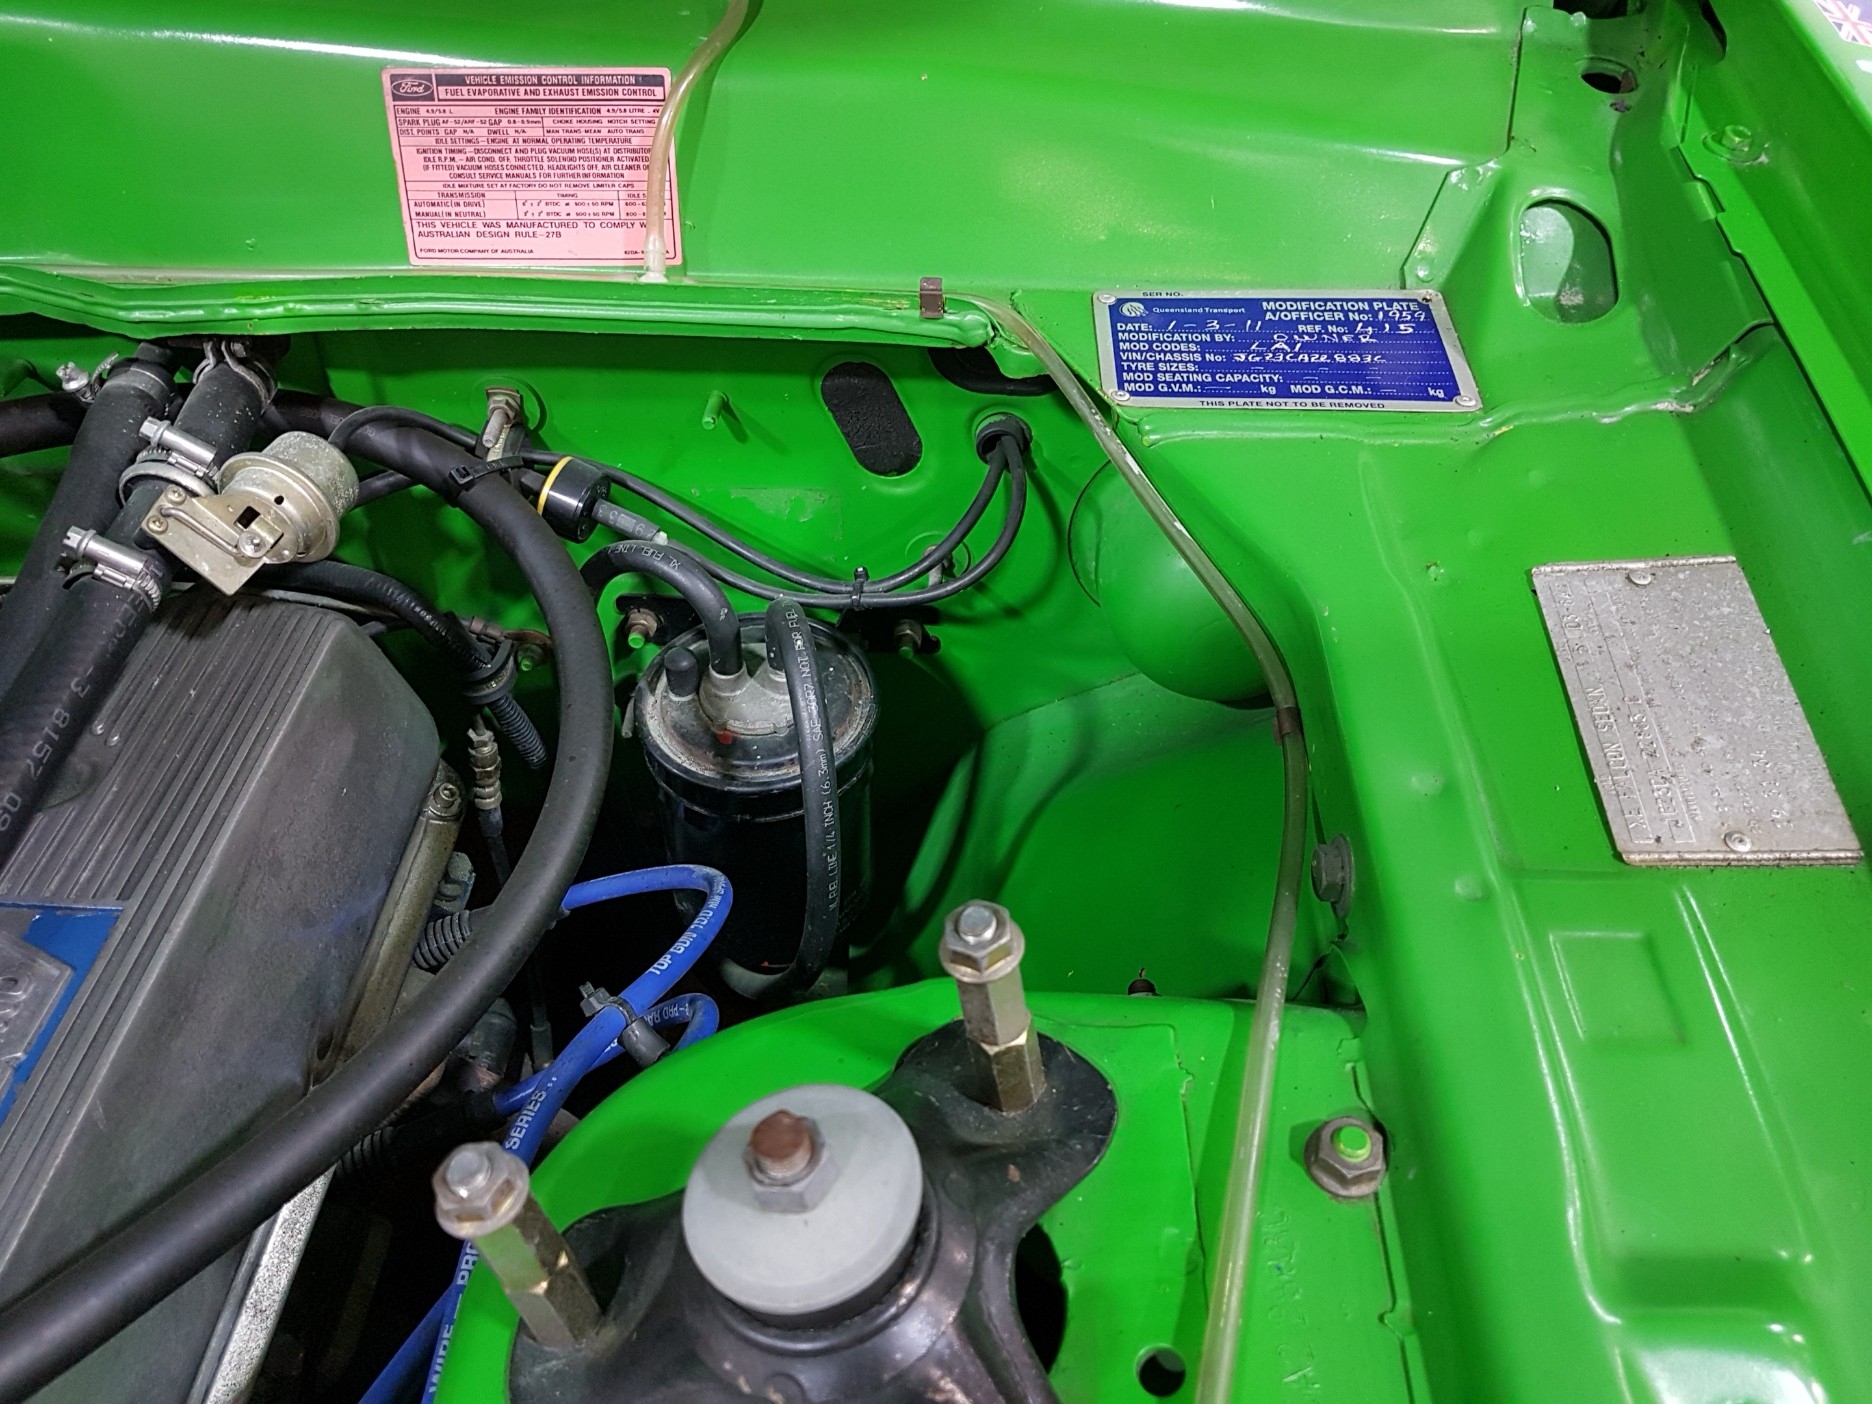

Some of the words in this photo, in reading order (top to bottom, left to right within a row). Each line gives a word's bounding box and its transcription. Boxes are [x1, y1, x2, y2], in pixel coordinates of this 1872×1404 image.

[465, 76, 496, 84] VEHICLE
[500, 76, 537, 84] EMISSION
[542, 76, 577, 84] CONTROL
[582, 76, 635, 84] INFORMATION
[400, 82, 424, 93] Ford
[1262, 302, 1369, 310] MODIFICATION
[1373, 302, 1420, 311] PLATE
[1265, 312, 1344, 320] A/OFFICER
[1349, 312, 1372, 321] No:
[1117, 323, 1152, 331] DATE:
[1118, 333, 1211, 342] MODIFICATION
[1119, 342, 1151, 350] MOD
[1153, 342, 1200, 351] CODES:
[1120, 352, 1202, 361] VIN/CHASSIS
[1205, 354, 1226, 362] No:
[1122, 362, 1155, 371] TYRE
[1159, 363, 1199, 371] SIZES:
[1123, 373, 1153, 381] MOD
[1157, 373, 1212, 382] SEATING
[1216, 374, 1283, 383] CAPACITY:
[1124, 383, 1154, 391] MOD
[1158, 383, 1202, 392] G.V.M.:
[1261, 385, 1276, 394] kg
[1290, 385, 1321, 393] MOD
[1325, 386, 1372, 394] G.C.M.:
[1428, 387, 1444, 397] kg
[614, 543, 636, 554] LINE
[640, 545, 664, 561] FUEL
[669, 555, 682, 570] XL
[786, 609, 800, 628] FUEL
[792, 632, 805, 651] FOR
[798, 655, 811, 678] NOT
[810, 718, 823, 742] SAE
[26, 708, 70, 780] 8157
[816, 748, 831, 795] (6.3mm)
[823, 800, 834, 827] INCH
[647, 954, 672, 975] TOP
[671, 930, 697, 954] GUN
[504, 1087, 547, 1150] SERIES
